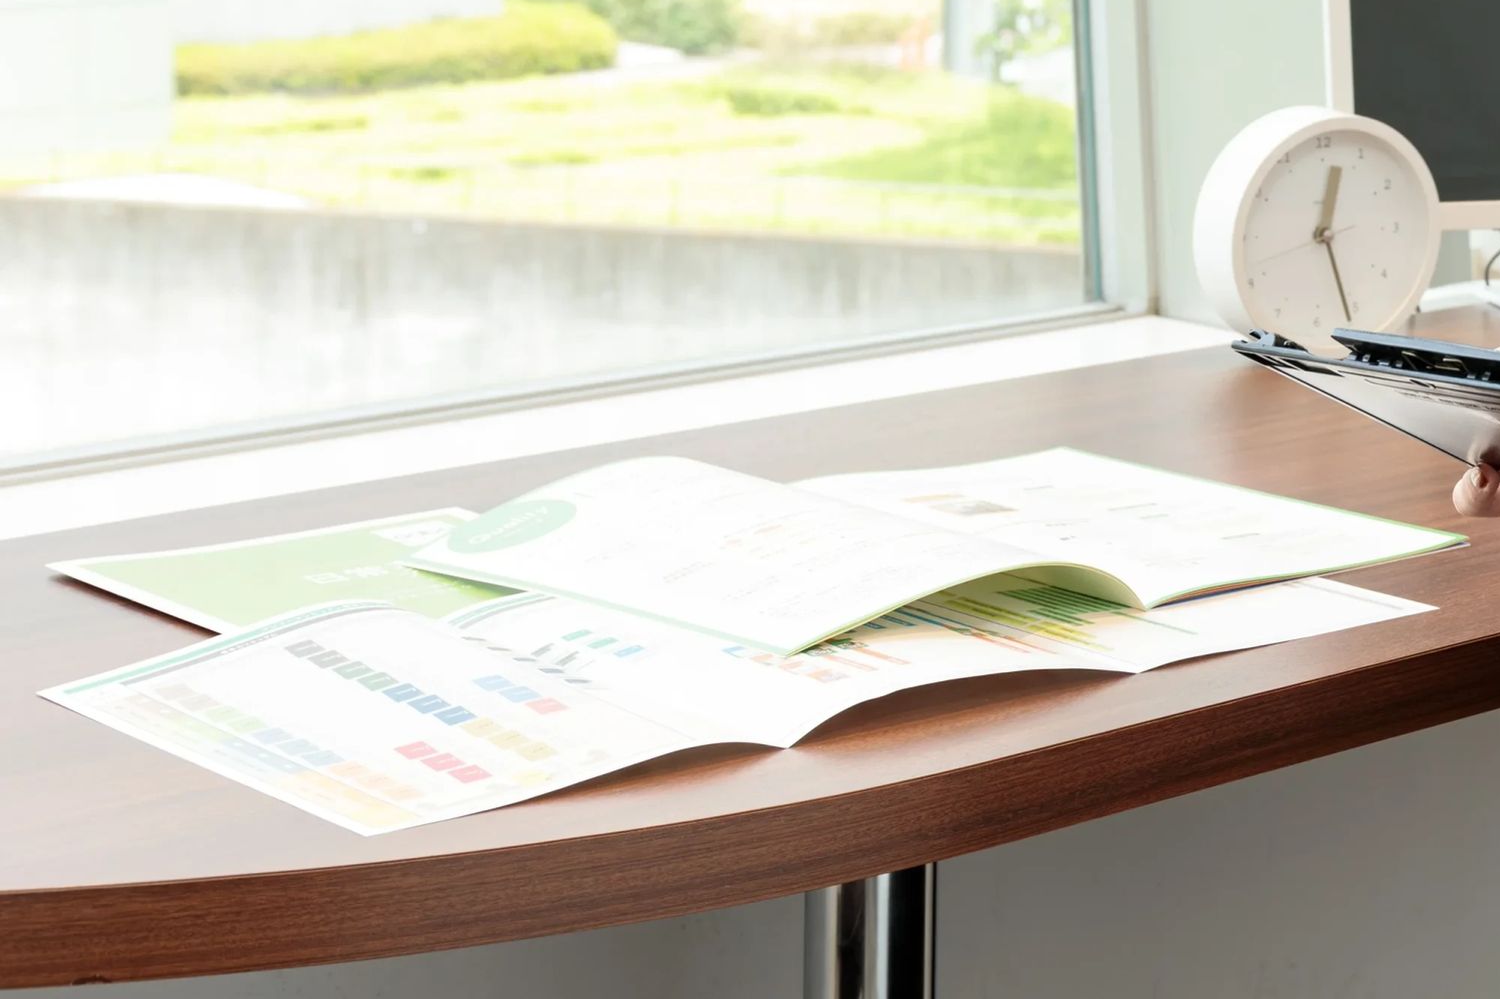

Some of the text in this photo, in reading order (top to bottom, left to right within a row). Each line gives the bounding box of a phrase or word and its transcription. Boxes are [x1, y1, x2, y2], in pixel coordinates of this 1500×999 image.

[1315, 136, 1331, 149] 12
[1357, 148, 1364, 159] 1
[1384, 178, 1392, 190] 2
